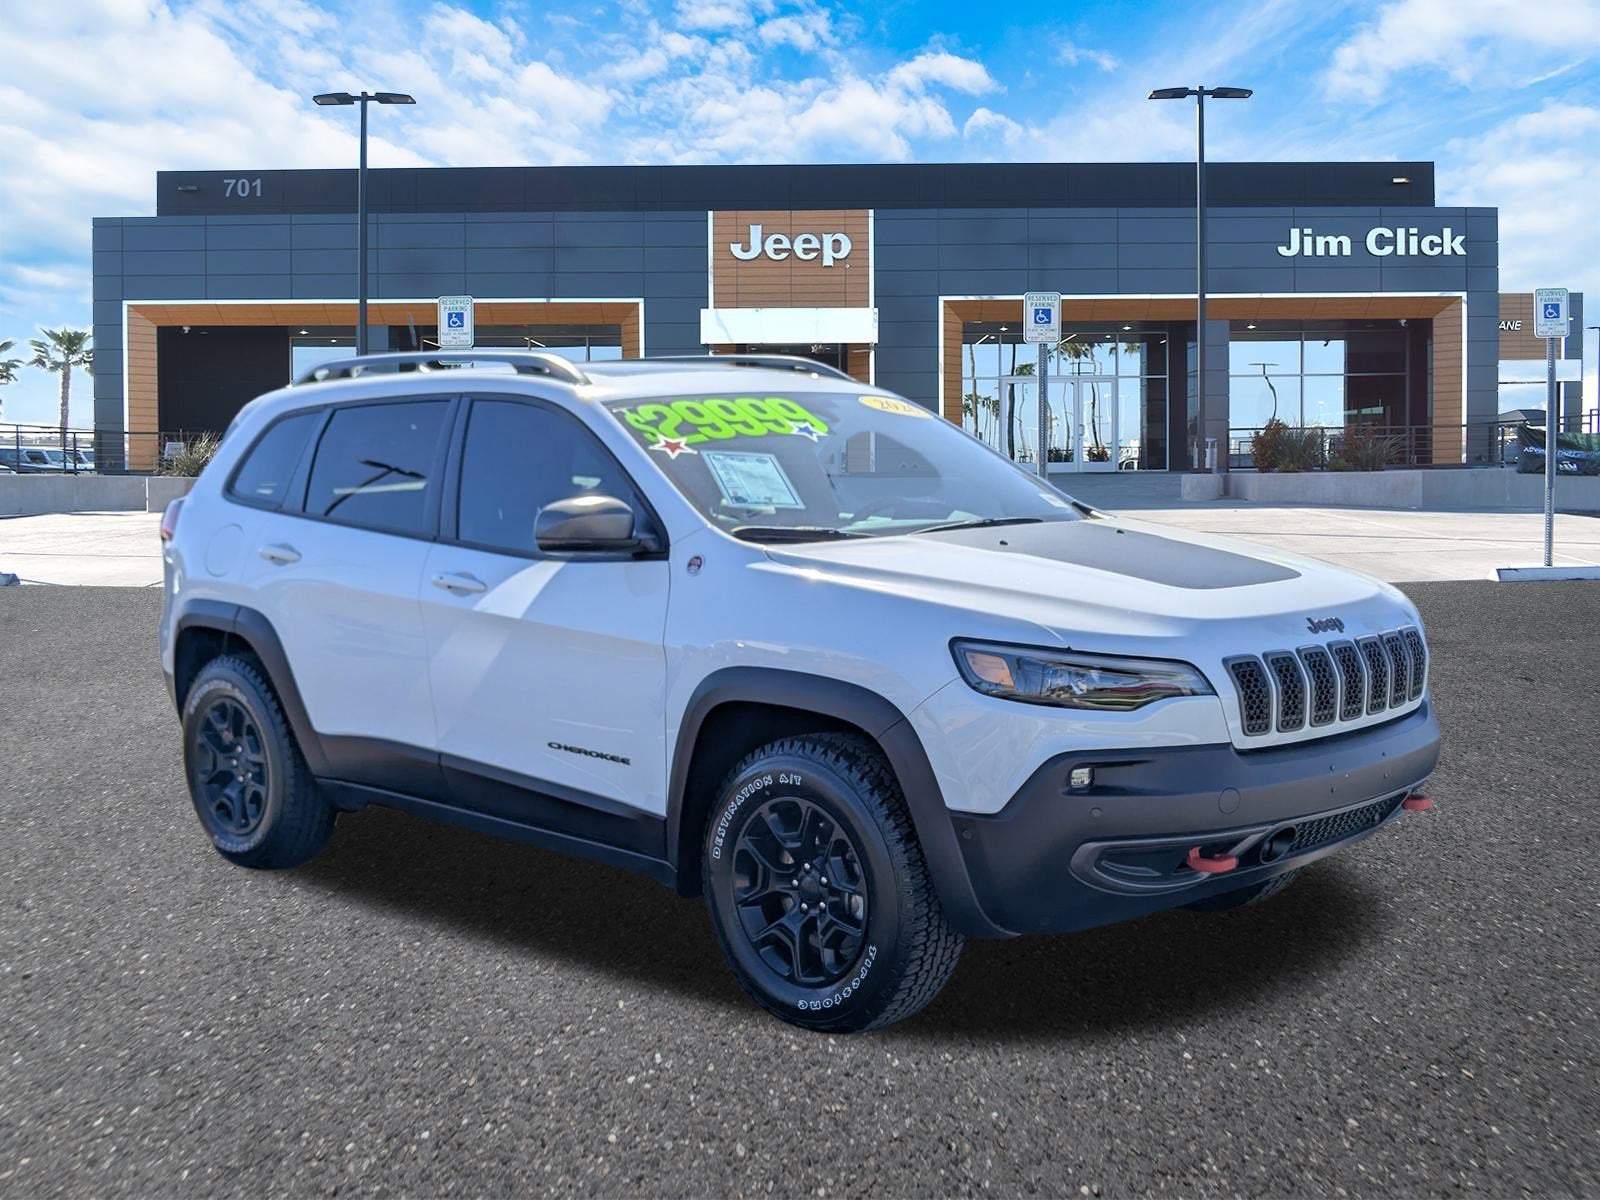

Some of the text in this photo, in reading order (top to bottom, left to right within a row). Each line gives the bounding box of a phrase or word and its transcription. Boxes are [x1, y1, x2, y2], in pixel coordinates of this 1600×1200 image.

[223, 178, 262, 197] 701
[729, 224, 852, 267] Jeep
[1276, 226, 1467, 257] Jim Click
[1306, 616, 1345, 634] Jeep
[547, 741, 631, 766] CHEROKEE
[712, 774, 774, 860] DESTINATION
